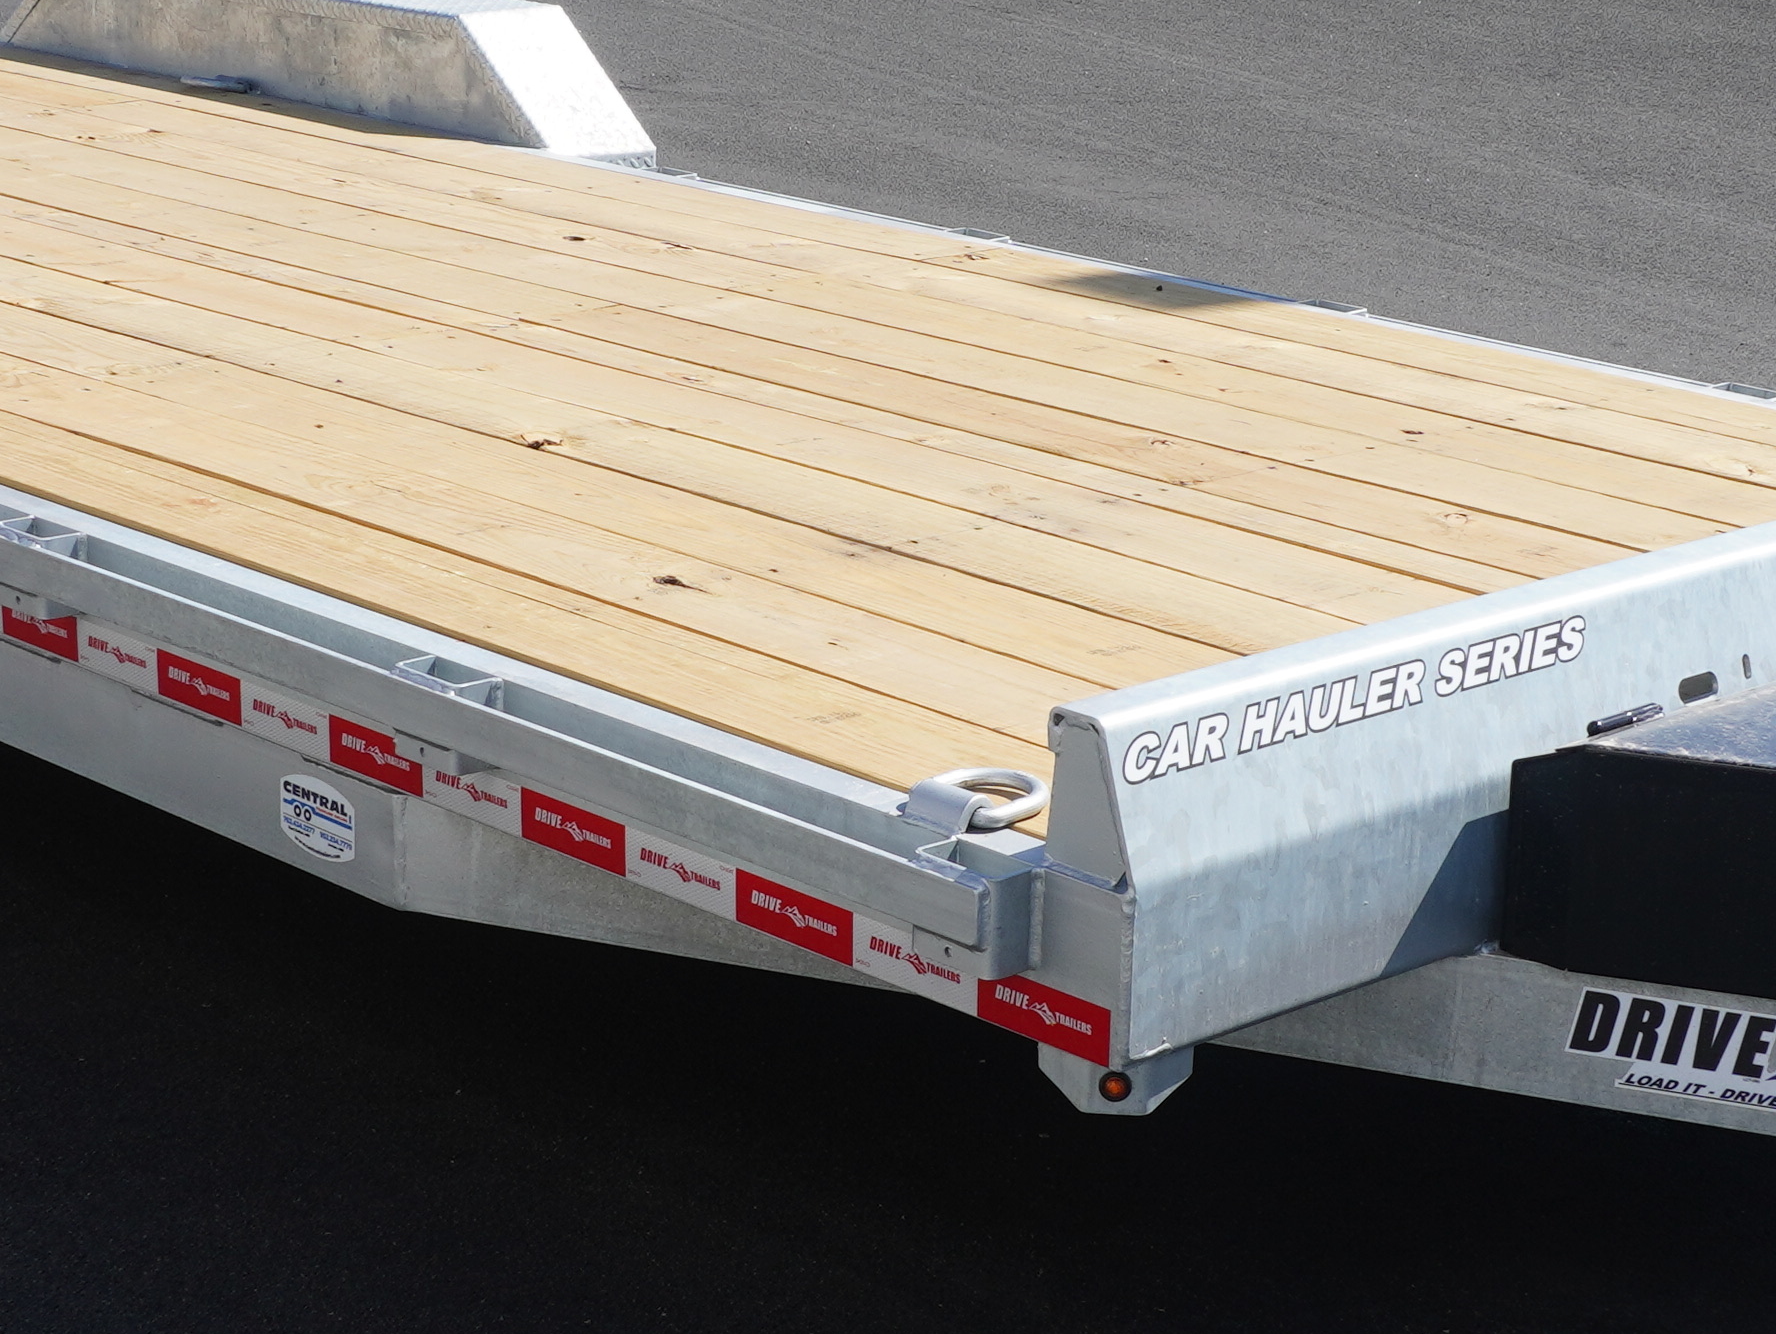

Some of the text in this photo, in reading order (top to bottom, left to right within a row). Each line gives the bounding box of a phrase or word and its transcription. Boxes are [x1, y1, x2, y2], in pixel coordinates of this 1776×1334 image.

[253, 699, 276, 717] DRIVE
[1122, 615, 1586, 785] CAR HAULER SERIES
[341, 732, 366, 753] DRIVE
[283, 780, 348, 817] CENTRAL
[534, 807, 563, 829] DRIVE
[640, 847, 720, 891] DRIVE TRAILERS
[751, 889, 837, 936] DRIVE TRAILERS
[869, 936, 961, 984] DRIVE TRAILERS
[995, 984, 1092, 1036] DRIVE TRAILERS
[1624, 1073, 1679, 1090] LOAD
[1683, 1082, 1706, 1095] IT
